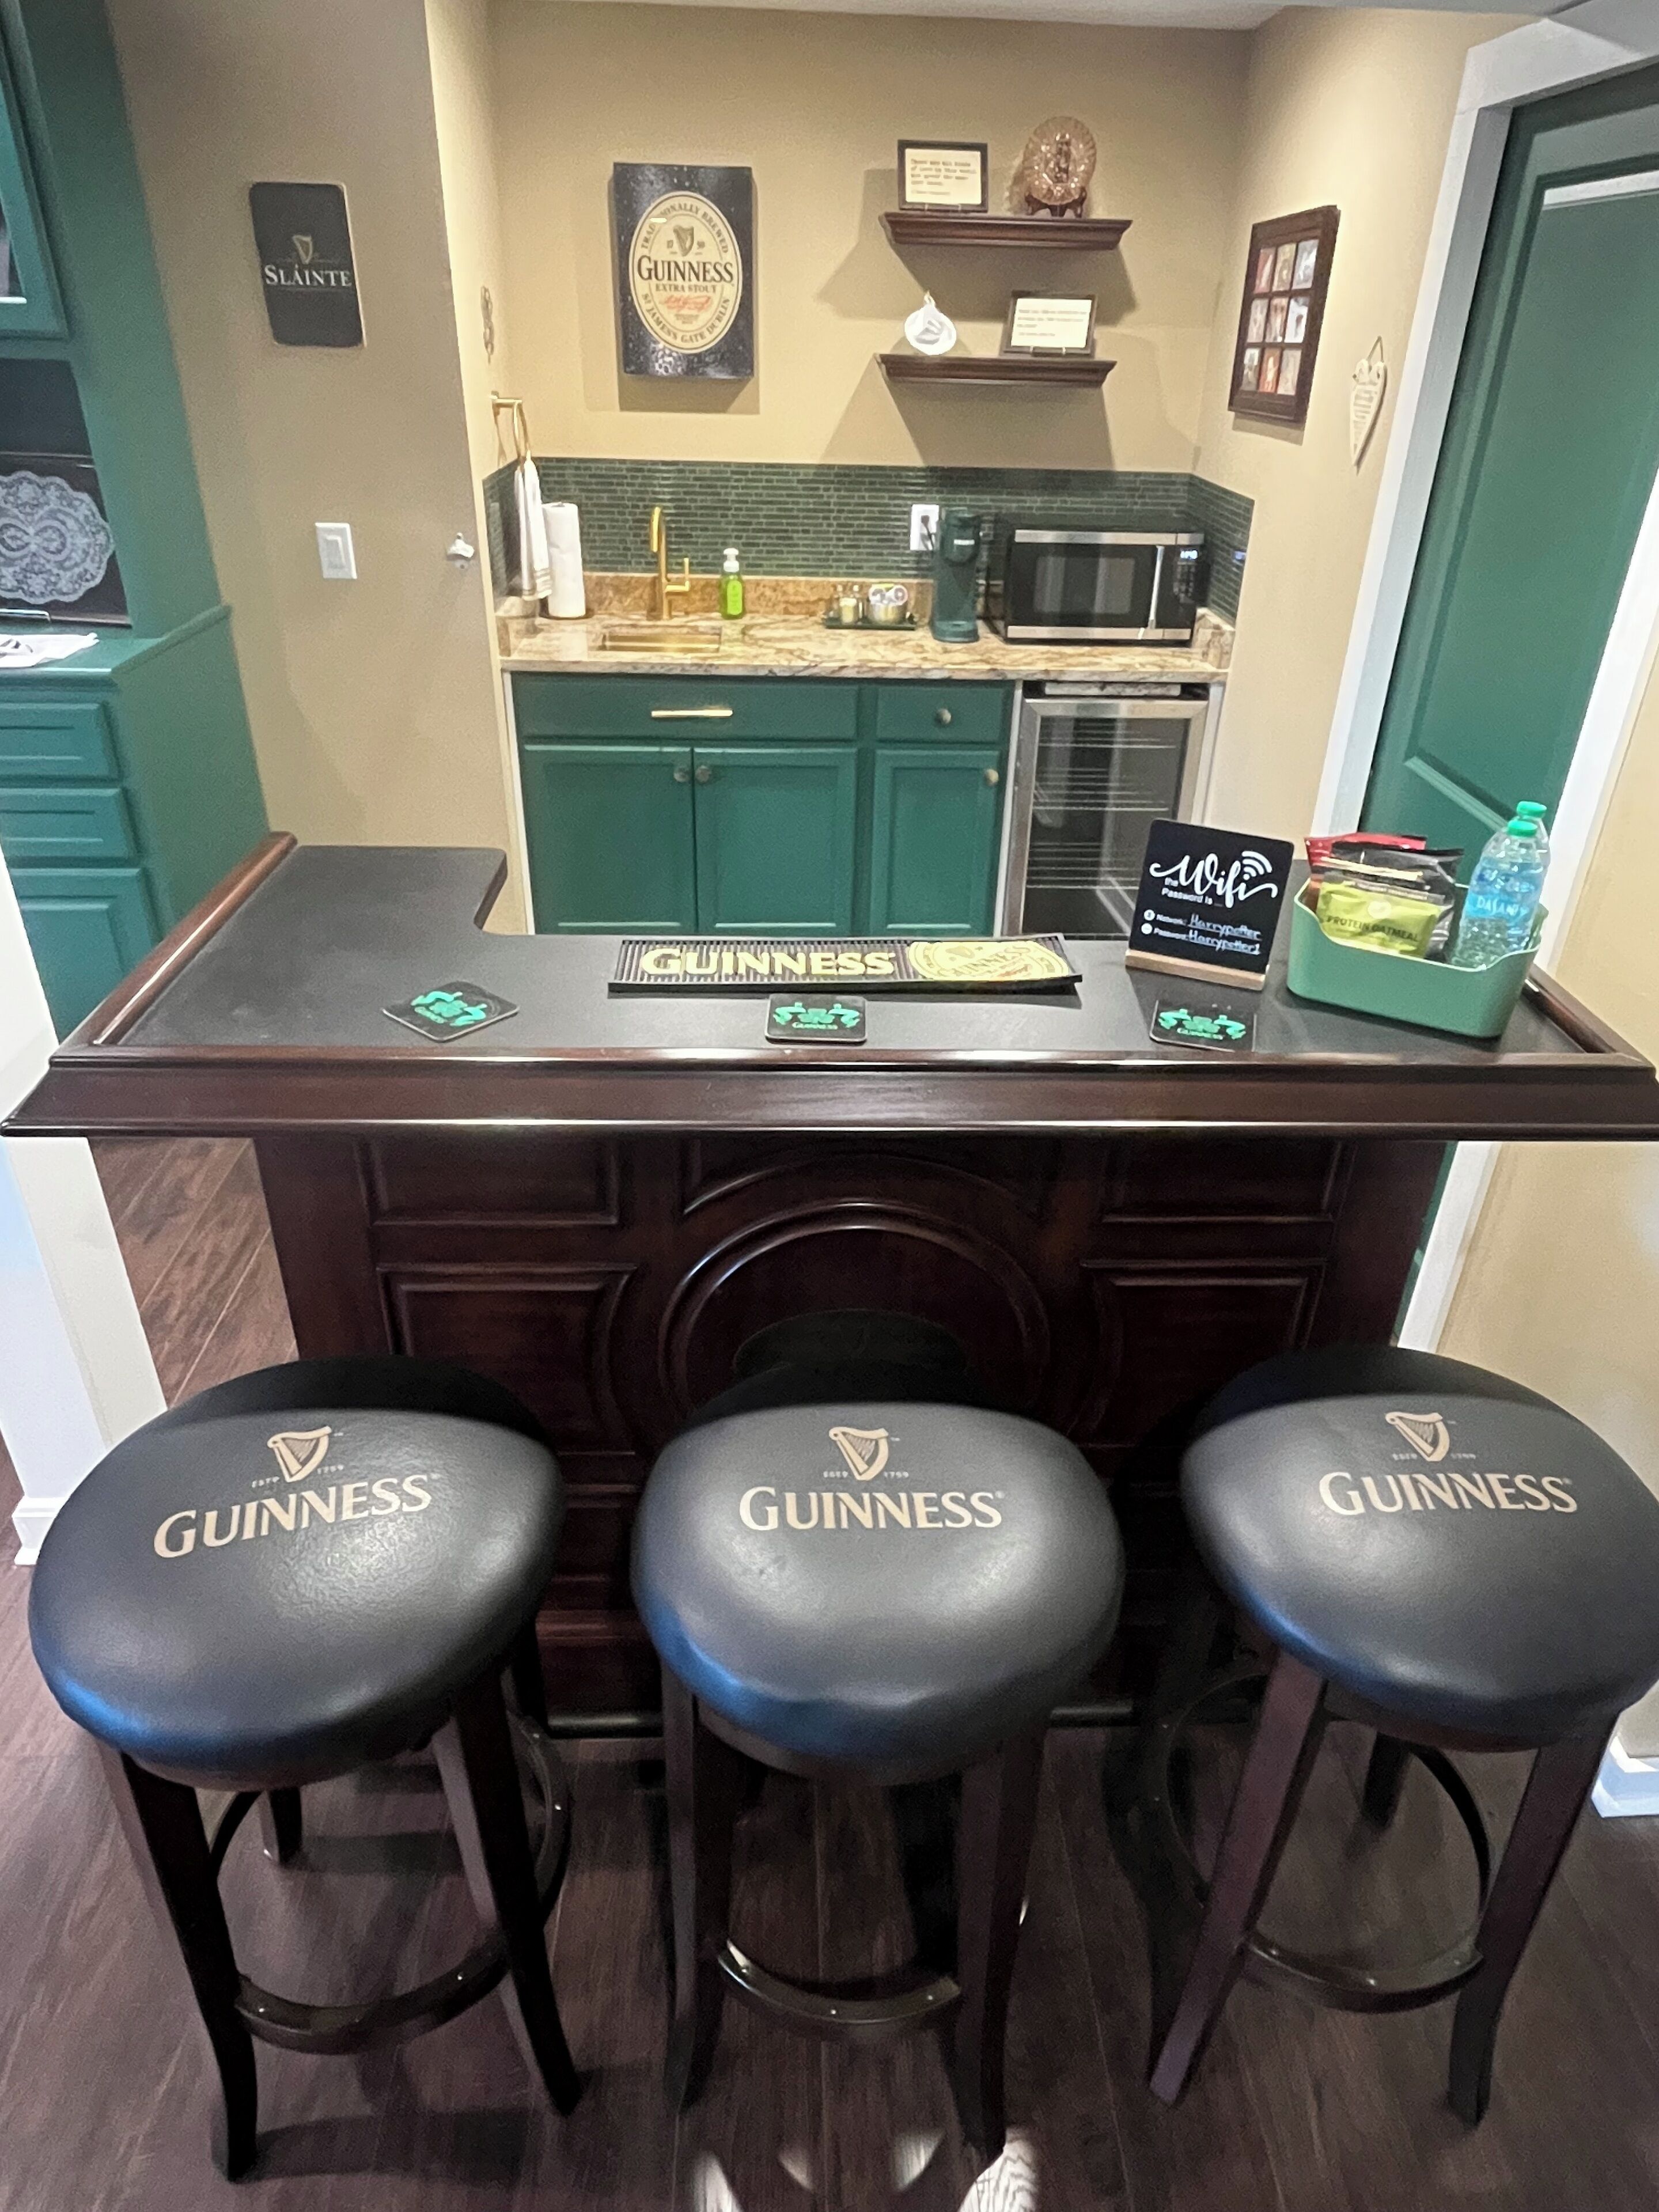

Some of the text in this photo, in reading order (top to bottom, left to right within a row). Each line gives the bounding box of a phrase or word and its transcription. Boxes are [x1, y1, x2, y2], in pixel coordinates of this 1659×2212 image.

[701, 211, 728, 253] BREWED
[637, 255, 734, 283] GUINNESS
[656, 283, 717, 293] EXTRA STOUT
[681, 332, 706, 343] GATE
[706, 298, 730, 334] DUBLIN
[1149, 853, 1278, 908] Wifi
[1327, 915, 1418, 942] PROTEIN OATMEAL
[642, 948, 894, 976] GUINNESS
[740, 1486, 1003, 1531] GUINNESS
[1319, 1472, 1578, 1516] GUINNESS
[154, 1474, 432, 1558] GUINNESS
